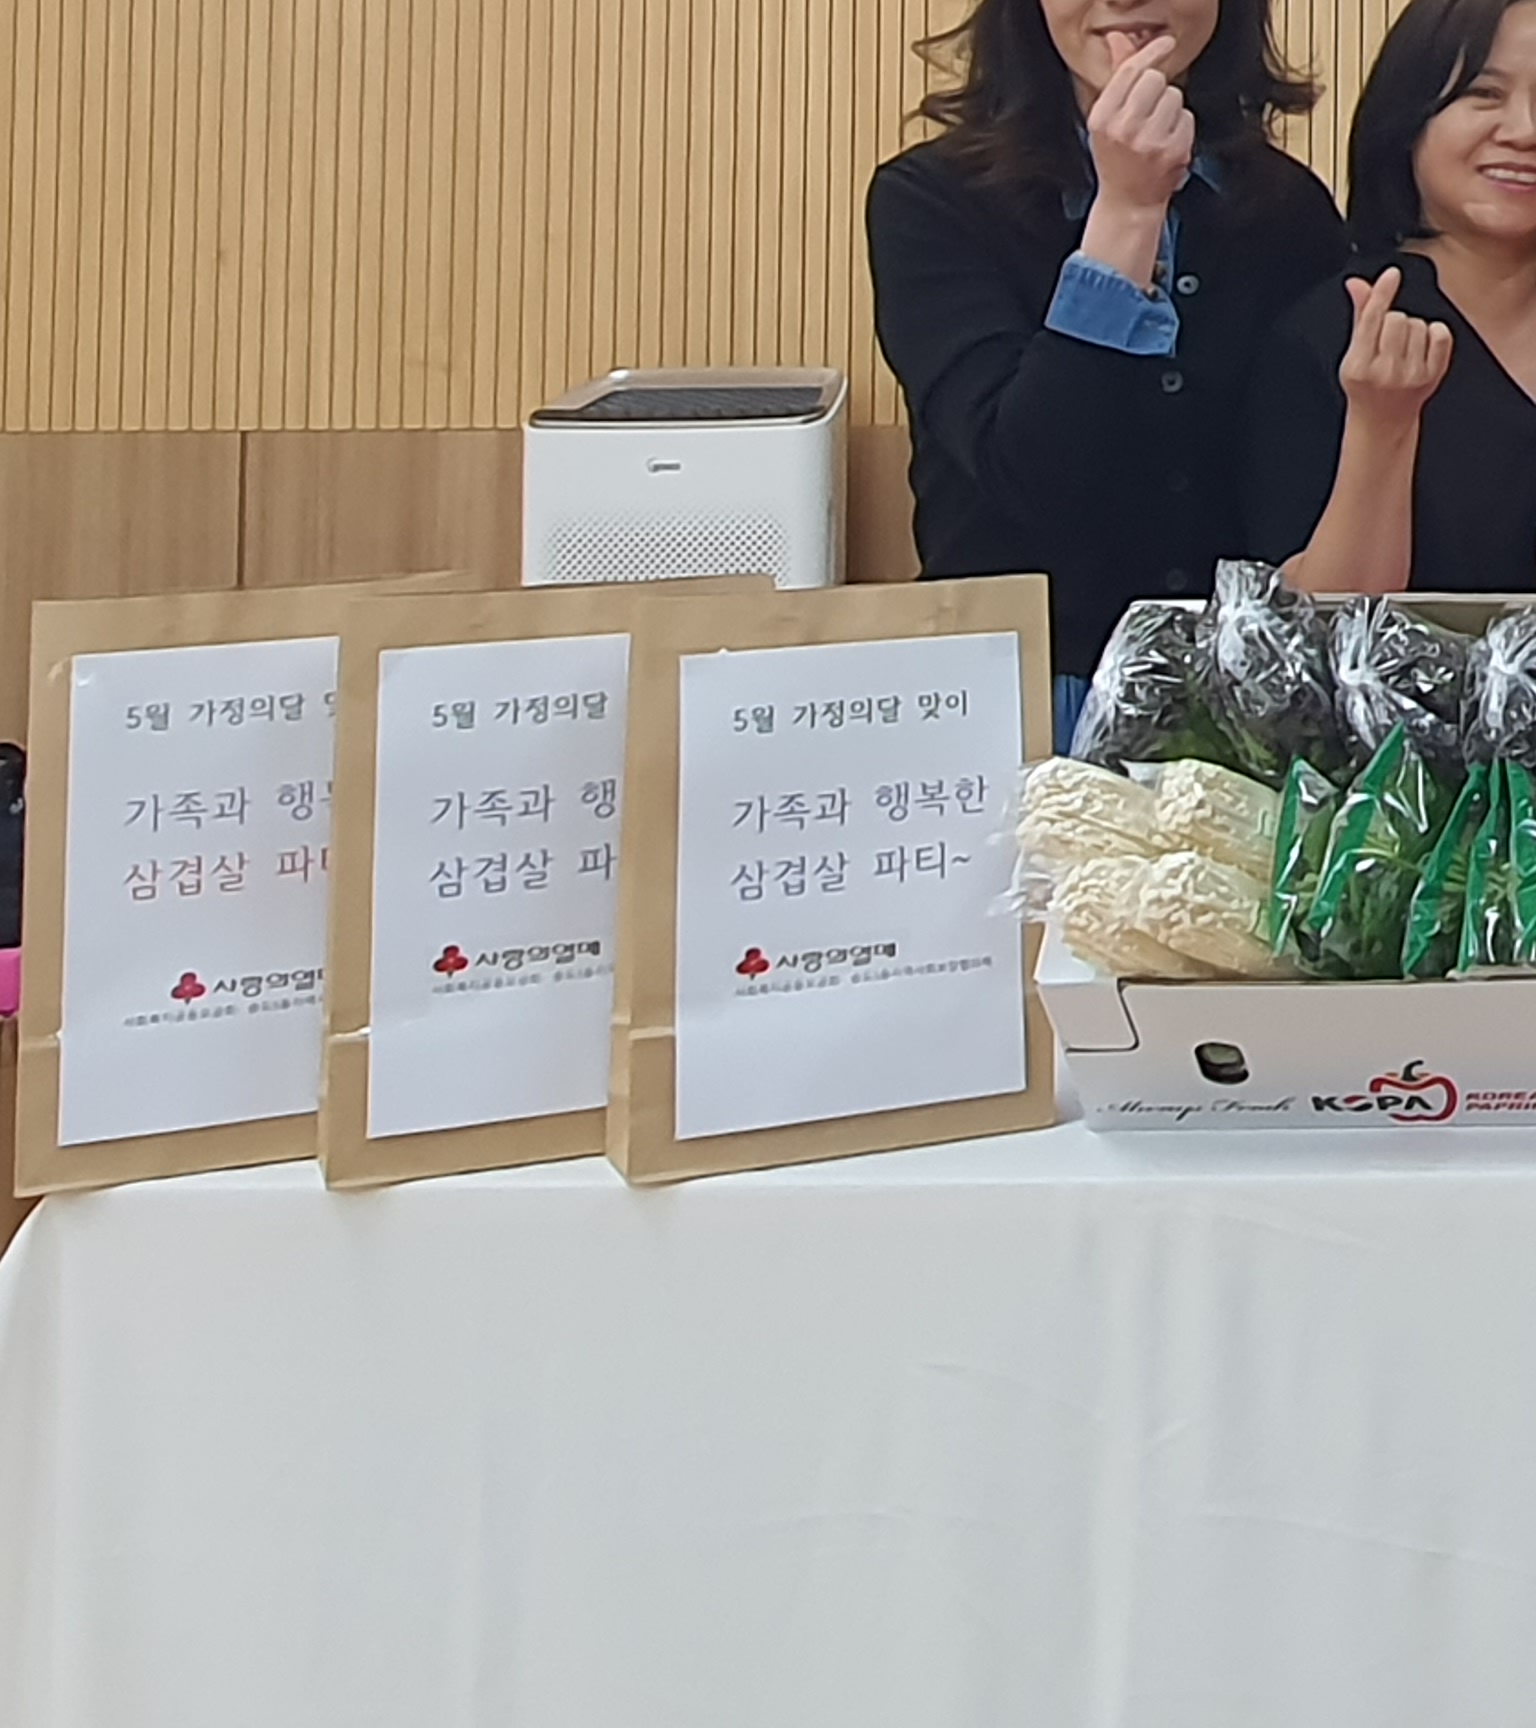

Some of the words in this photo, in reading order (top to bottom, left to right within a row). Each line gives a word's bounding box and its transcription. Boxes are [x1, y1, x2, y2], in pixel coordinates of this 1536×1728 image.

[125, 702, 170, 731] 5월
[189, 693, 305, 728] 가정의달
[432, 701, 475, 729] 5월
[494, 691, 608, 725] 가정의달
[734, 705, 774, 734] 5월
[792, 695, 901, 725] 가정의달
[918, 689, 967, 721] 맞이
[124, 786, 251, 833] 가족과
[430, 784, 556, 830] 가족과
[733, 787, 852, 834] 가족과
[875, 775, 990, 822] 행복한
[122, 851, 250, 901] 삼겹살
[276, 845, 329, 884] 파
[429, 848, 554, 898] 삼겹살
[730, 851, 850, 901] 삼겹살
[874, 841, 972, 883] 파티~
[776, 942, 896, 972] 사랑의열매
